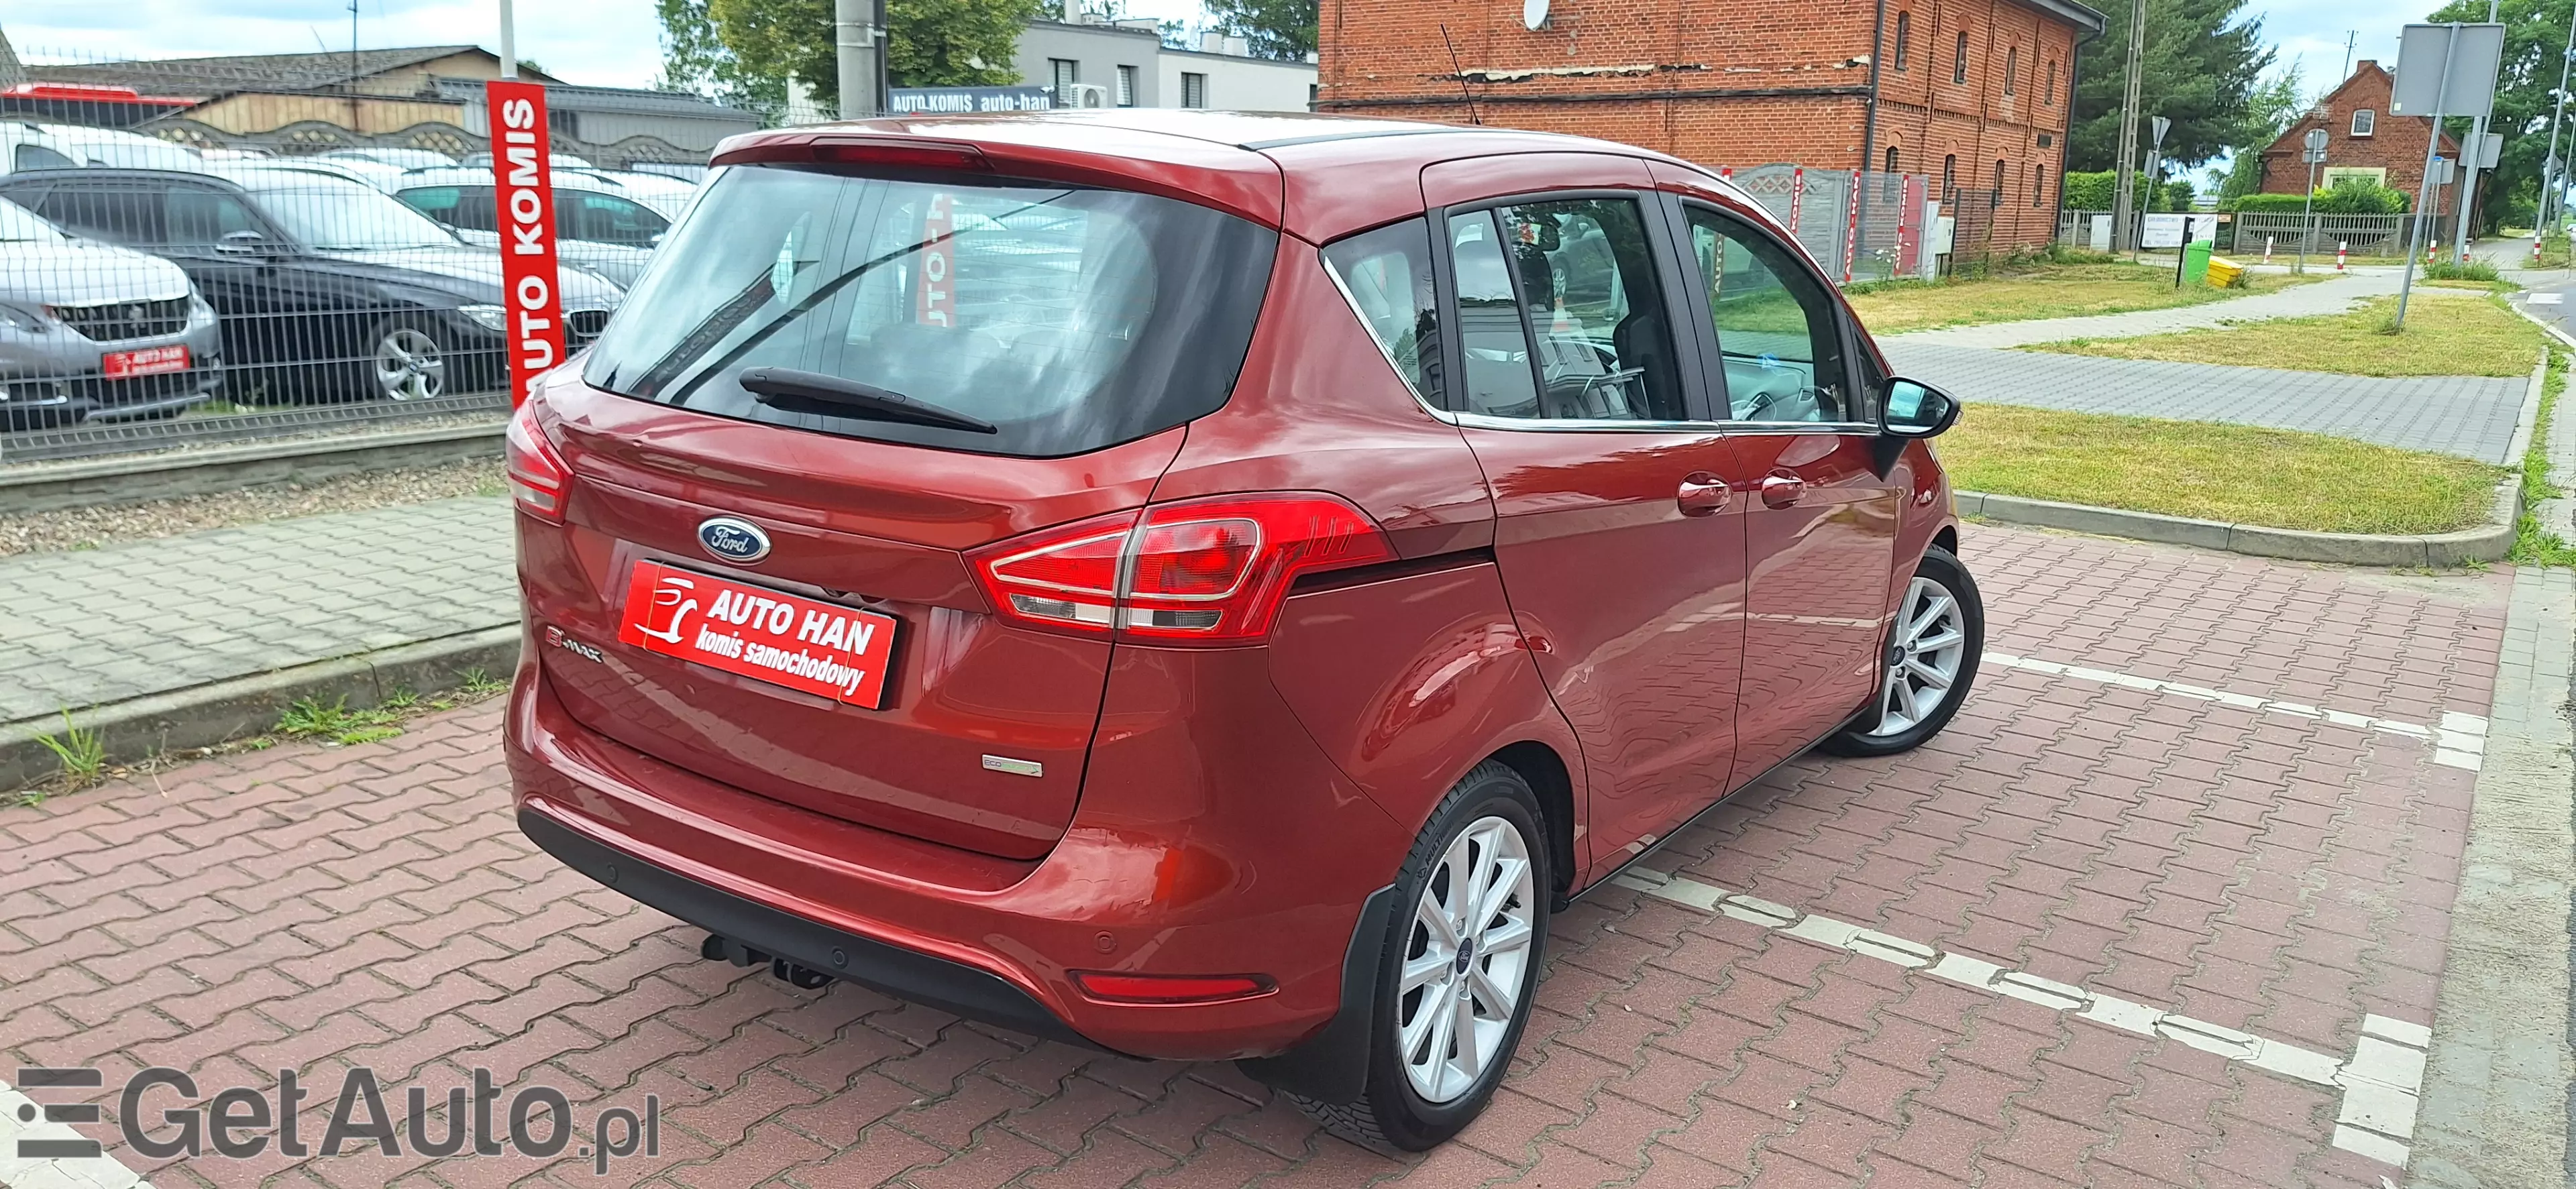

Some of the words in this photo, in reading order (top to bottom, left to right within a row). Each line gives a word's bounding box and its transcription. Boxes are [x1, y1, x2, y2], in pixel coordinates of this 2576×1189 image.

[894, 95, 926, 112] AUTO
[929, 94, 973, 112] KOMIS
[981, 93, 1051, 111] auto-han
[502, 98, 544, 255] KOMIS
[1790, 174, 1801, 230] KOMIS
[1900, 179, 1908, 227] KOMIS
[1845, 227, 1854, 276] AUTO
[711, 526, 749, 553] Ford
[707, 589, 795, 636] AUTO
[797, 609, 875, 656] HAN
[695, 623, 741, 659] komis
[743, 641, 866, 697] samochodowy
